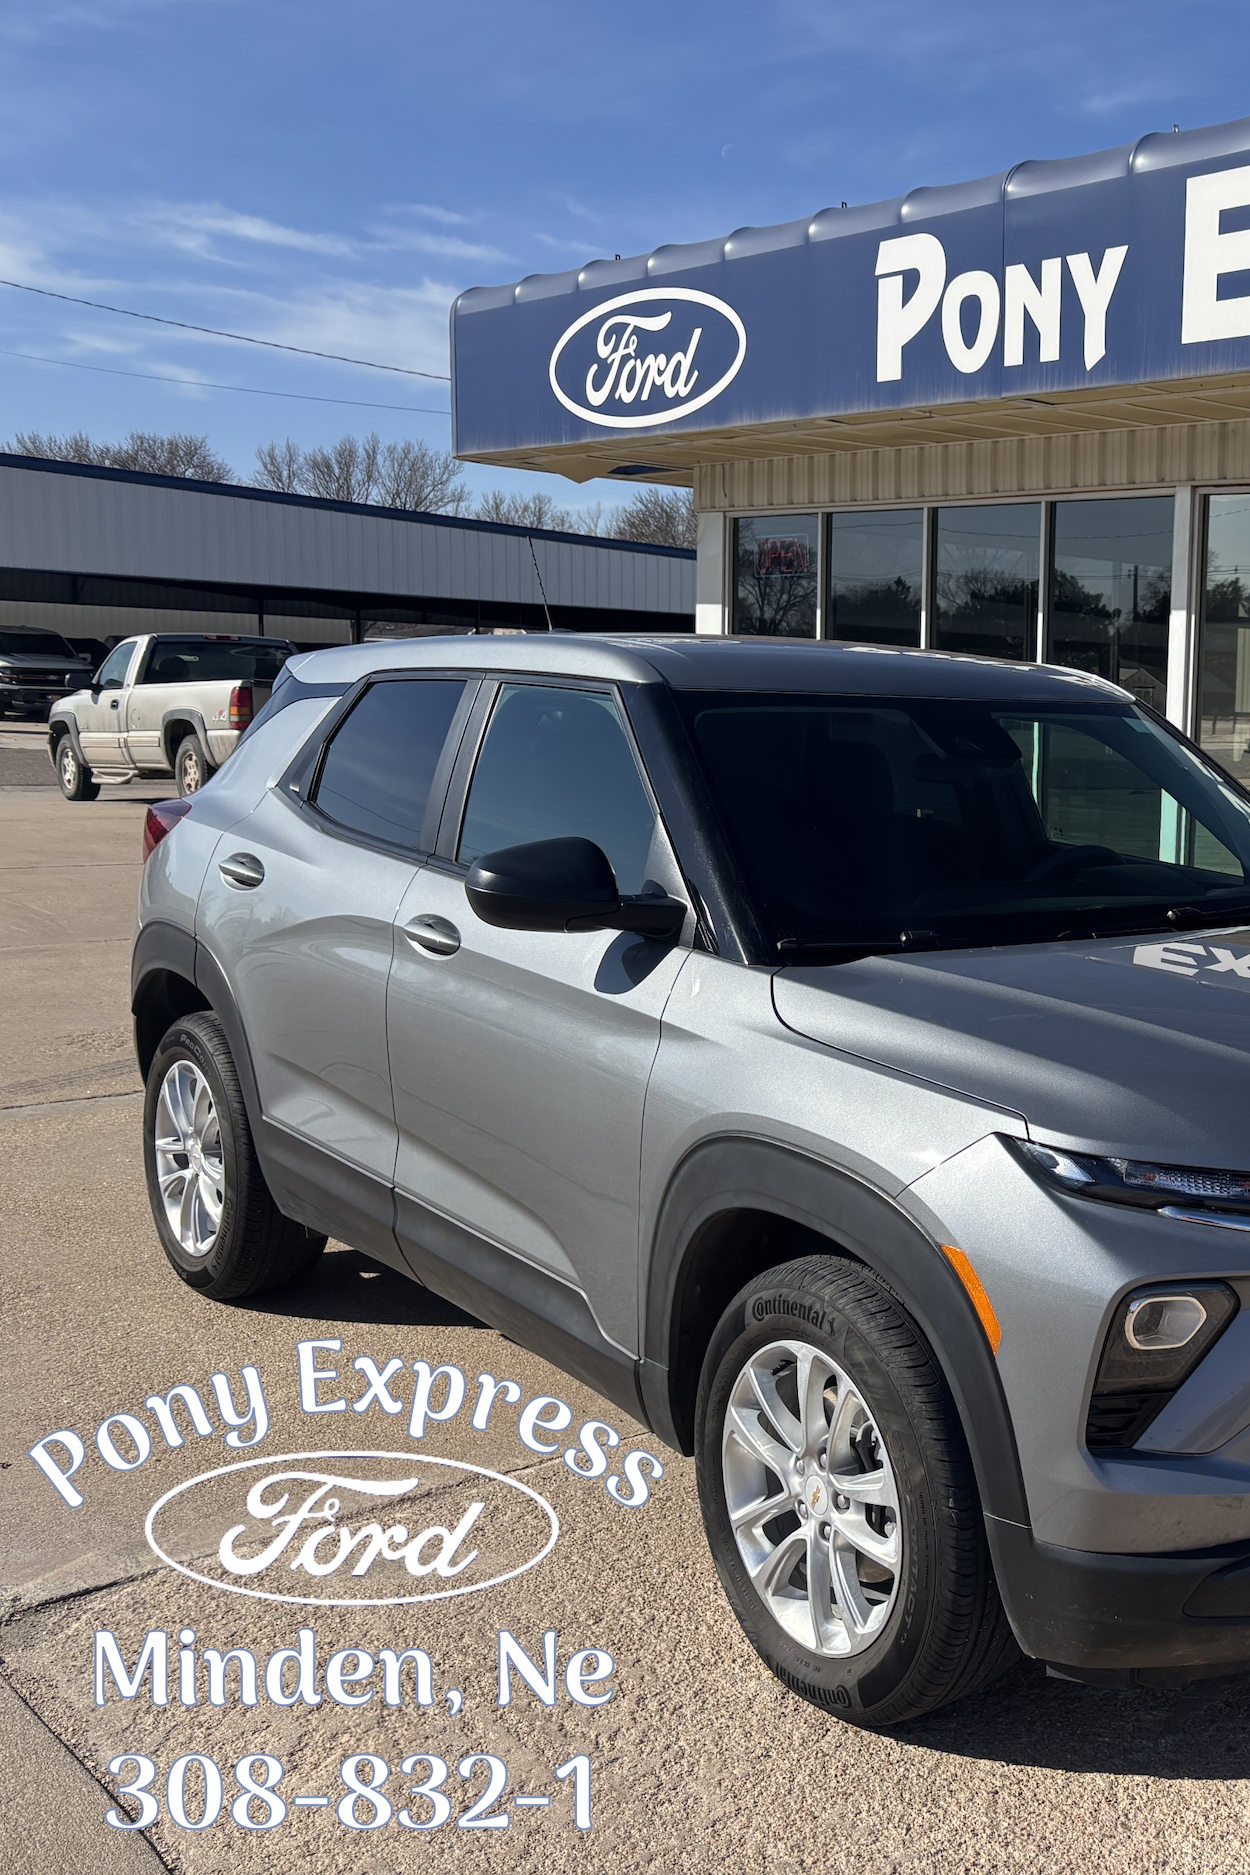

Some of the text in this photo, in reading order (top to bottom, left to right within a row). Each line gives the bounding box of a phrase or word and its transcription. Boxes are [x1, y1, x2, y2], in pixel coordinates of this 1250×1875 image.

[874, 232, 1129, 383] PONY
[585, 311, 703, 407] Ford
[756, 537, 808, 574] OPEN
[752, 1294, 827, 1331] Continental
